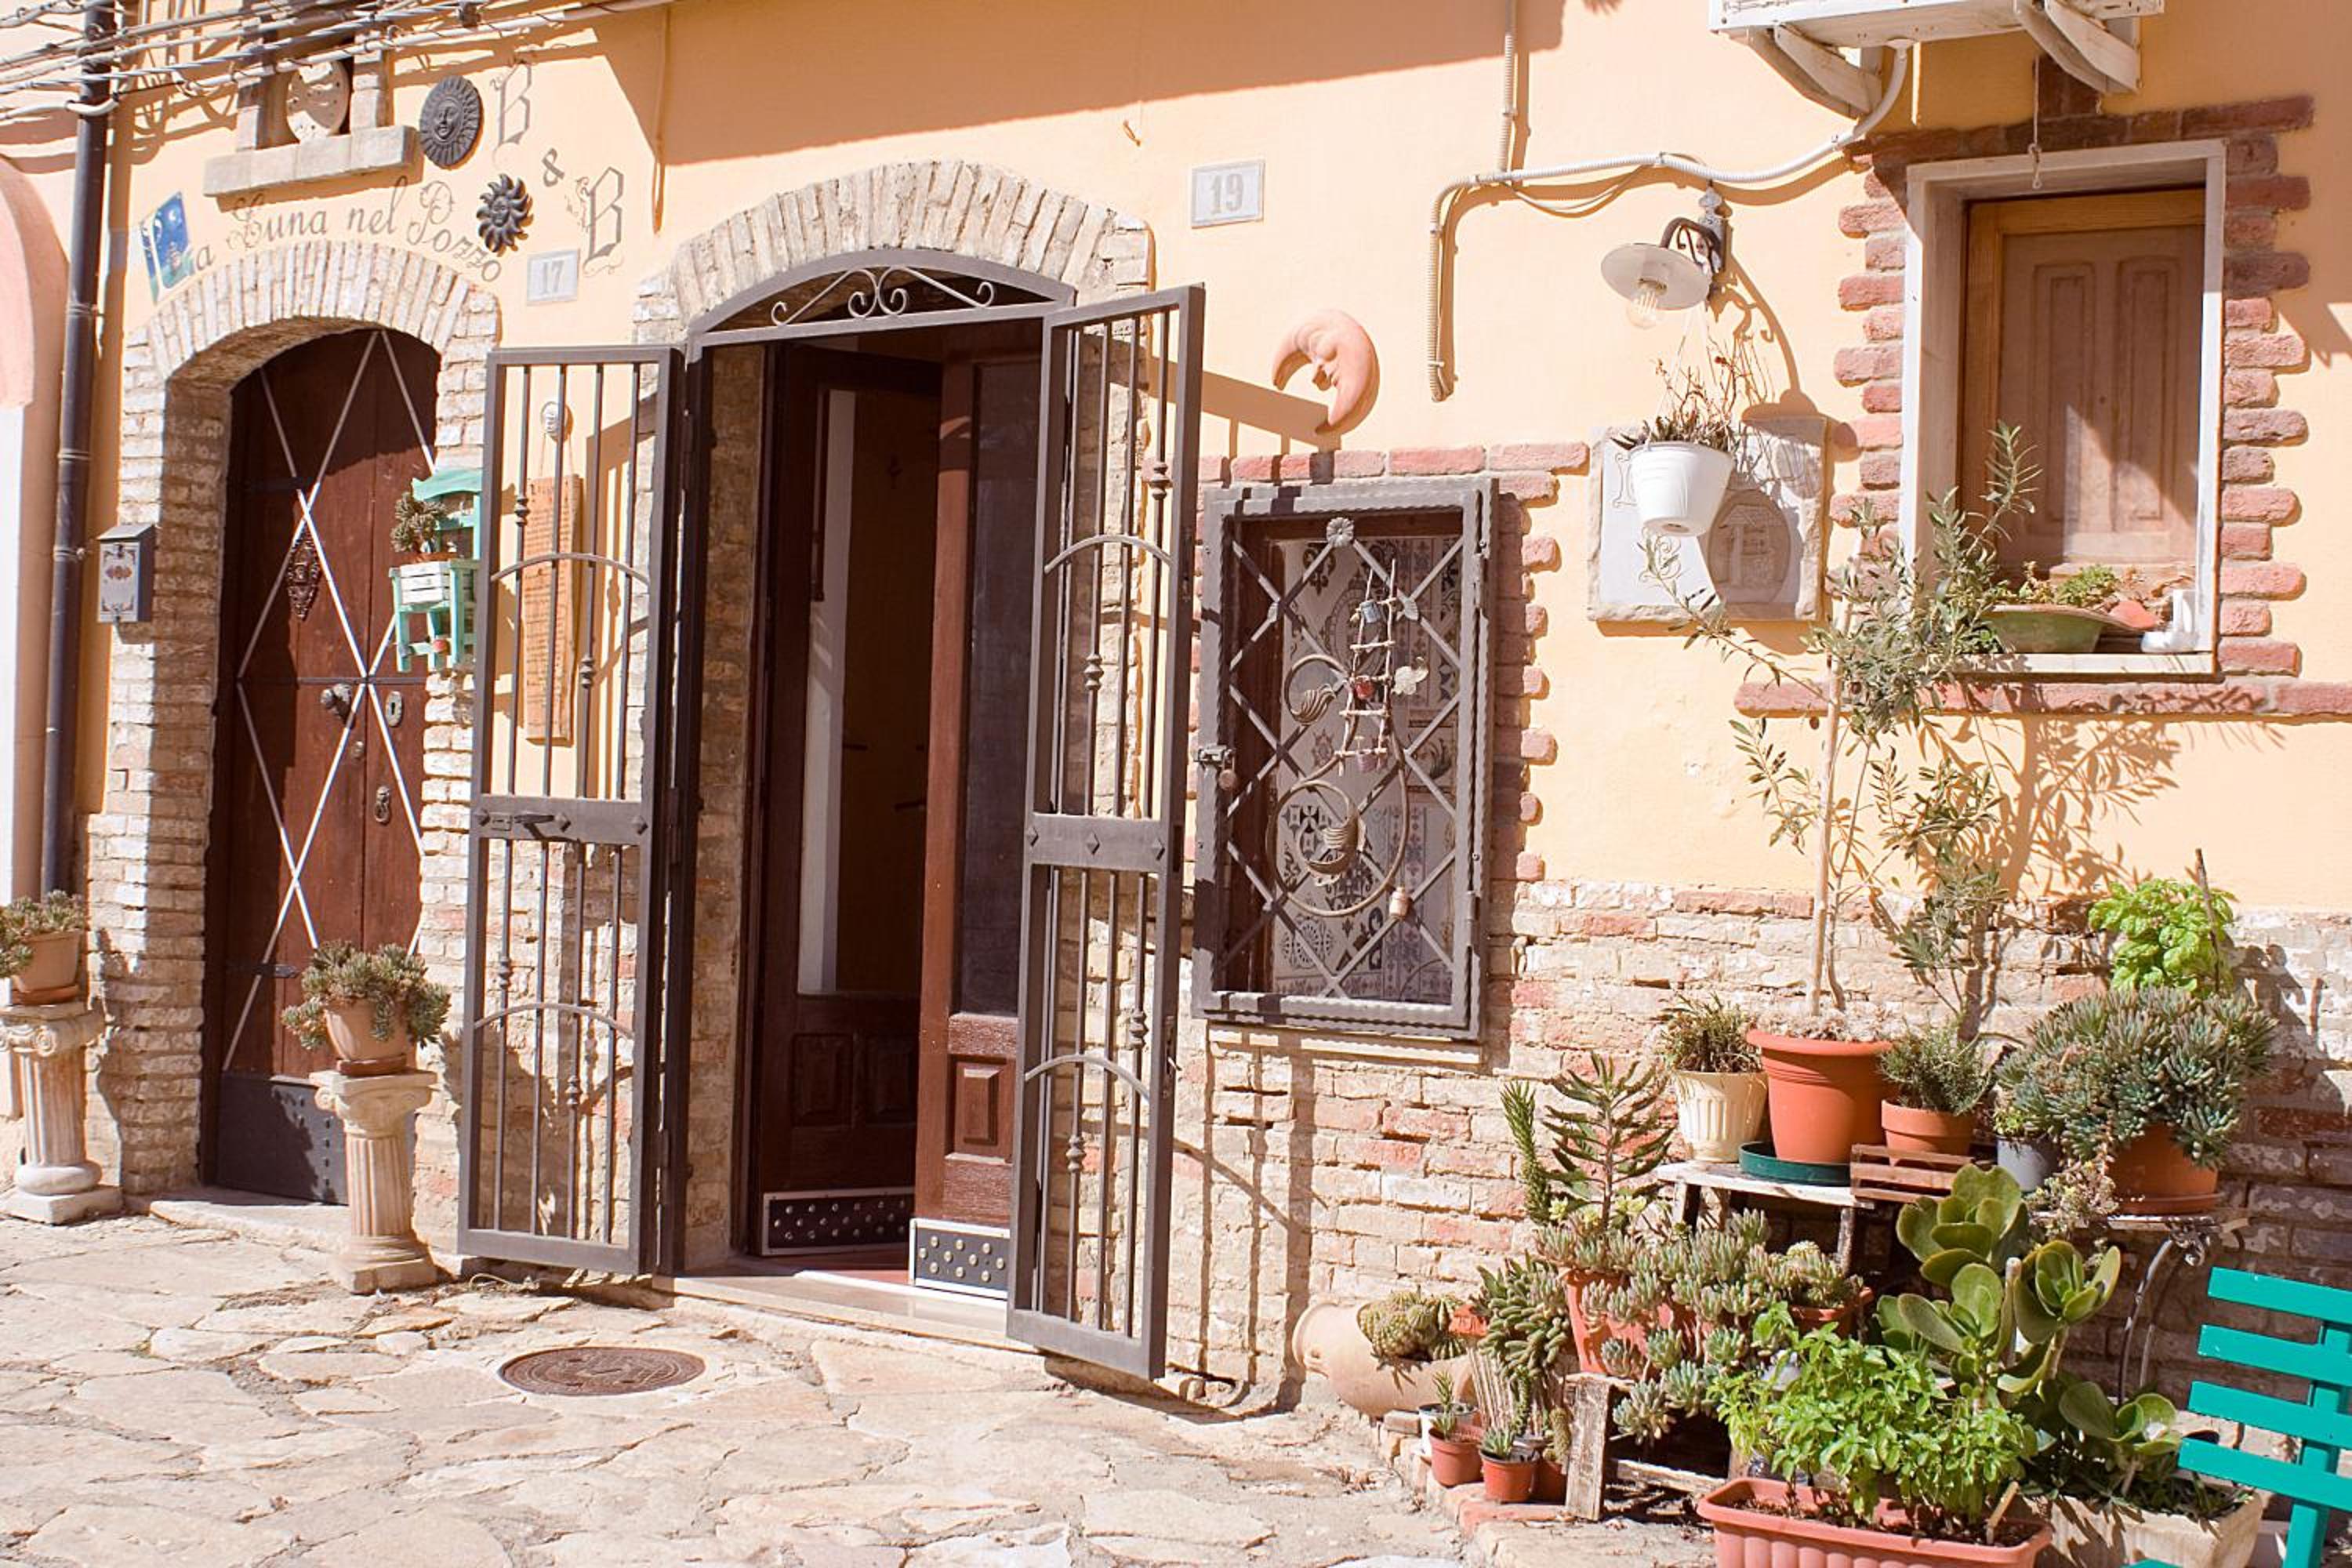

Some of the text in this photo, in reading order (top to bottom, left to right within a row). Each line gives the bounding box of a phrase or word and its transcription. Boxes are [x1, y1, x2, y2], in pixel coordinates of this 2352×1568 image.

[491, 60, 625, 274] B & B
[1210, 172, 1245, 215] 19
[227, 192, 328, 249] Luna
[347, 175, 410, 234] nel
[406, 180, 502, 282] Pozzo
[539, 260, 565, 294] 17
